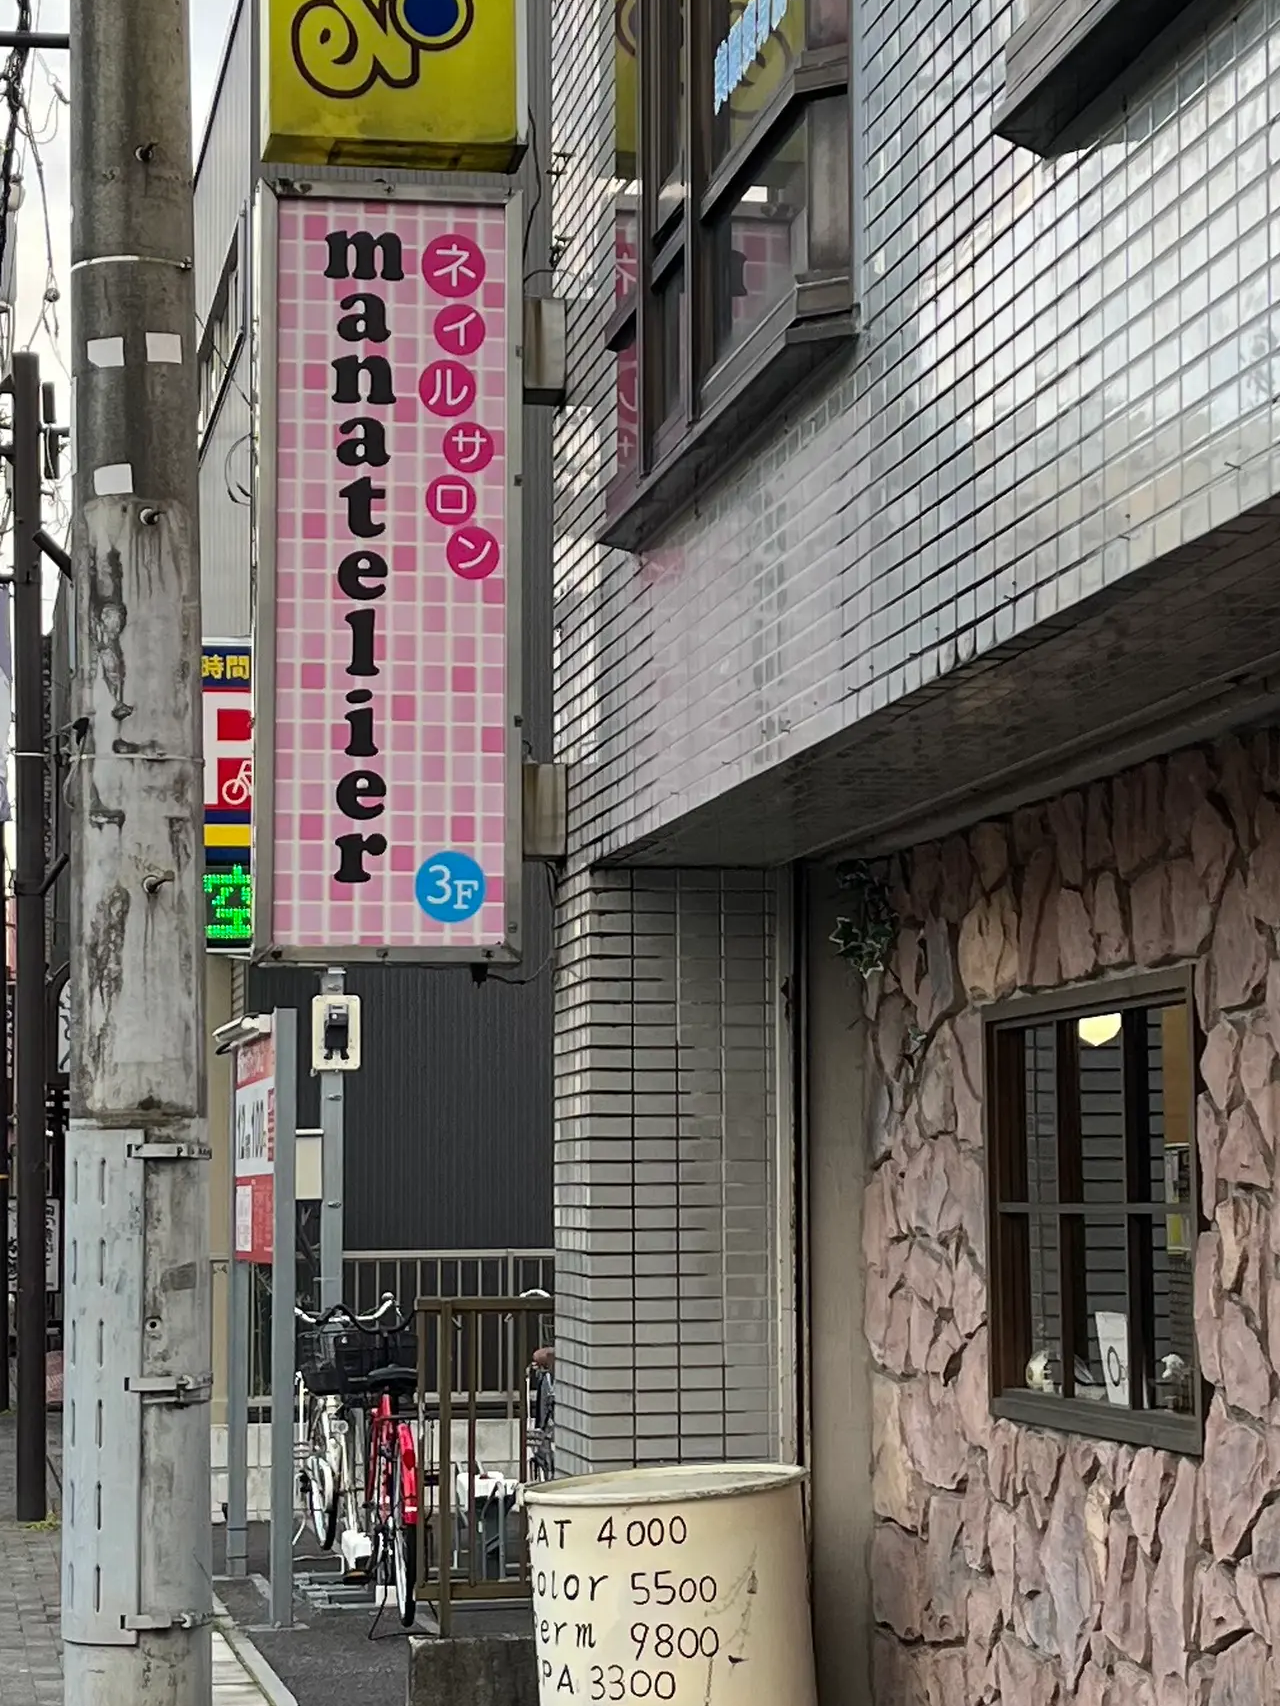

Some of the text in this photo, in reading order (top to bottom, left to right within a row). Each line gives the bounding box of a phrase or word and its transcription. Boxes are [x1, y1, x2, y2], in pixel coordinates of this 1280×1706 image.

[426, 242, 498, 572] ネイルサロン
[323, 229, 405, 884] manatelier
[426, 863, 480, 910] 3F
[597, 1515, 687, 1550] 4000
[532, 1568, 717, 1605] olor 5500
[630, 1622, 719, 1661] 9800
[538, 1656, 676, 1701] PA 3300
